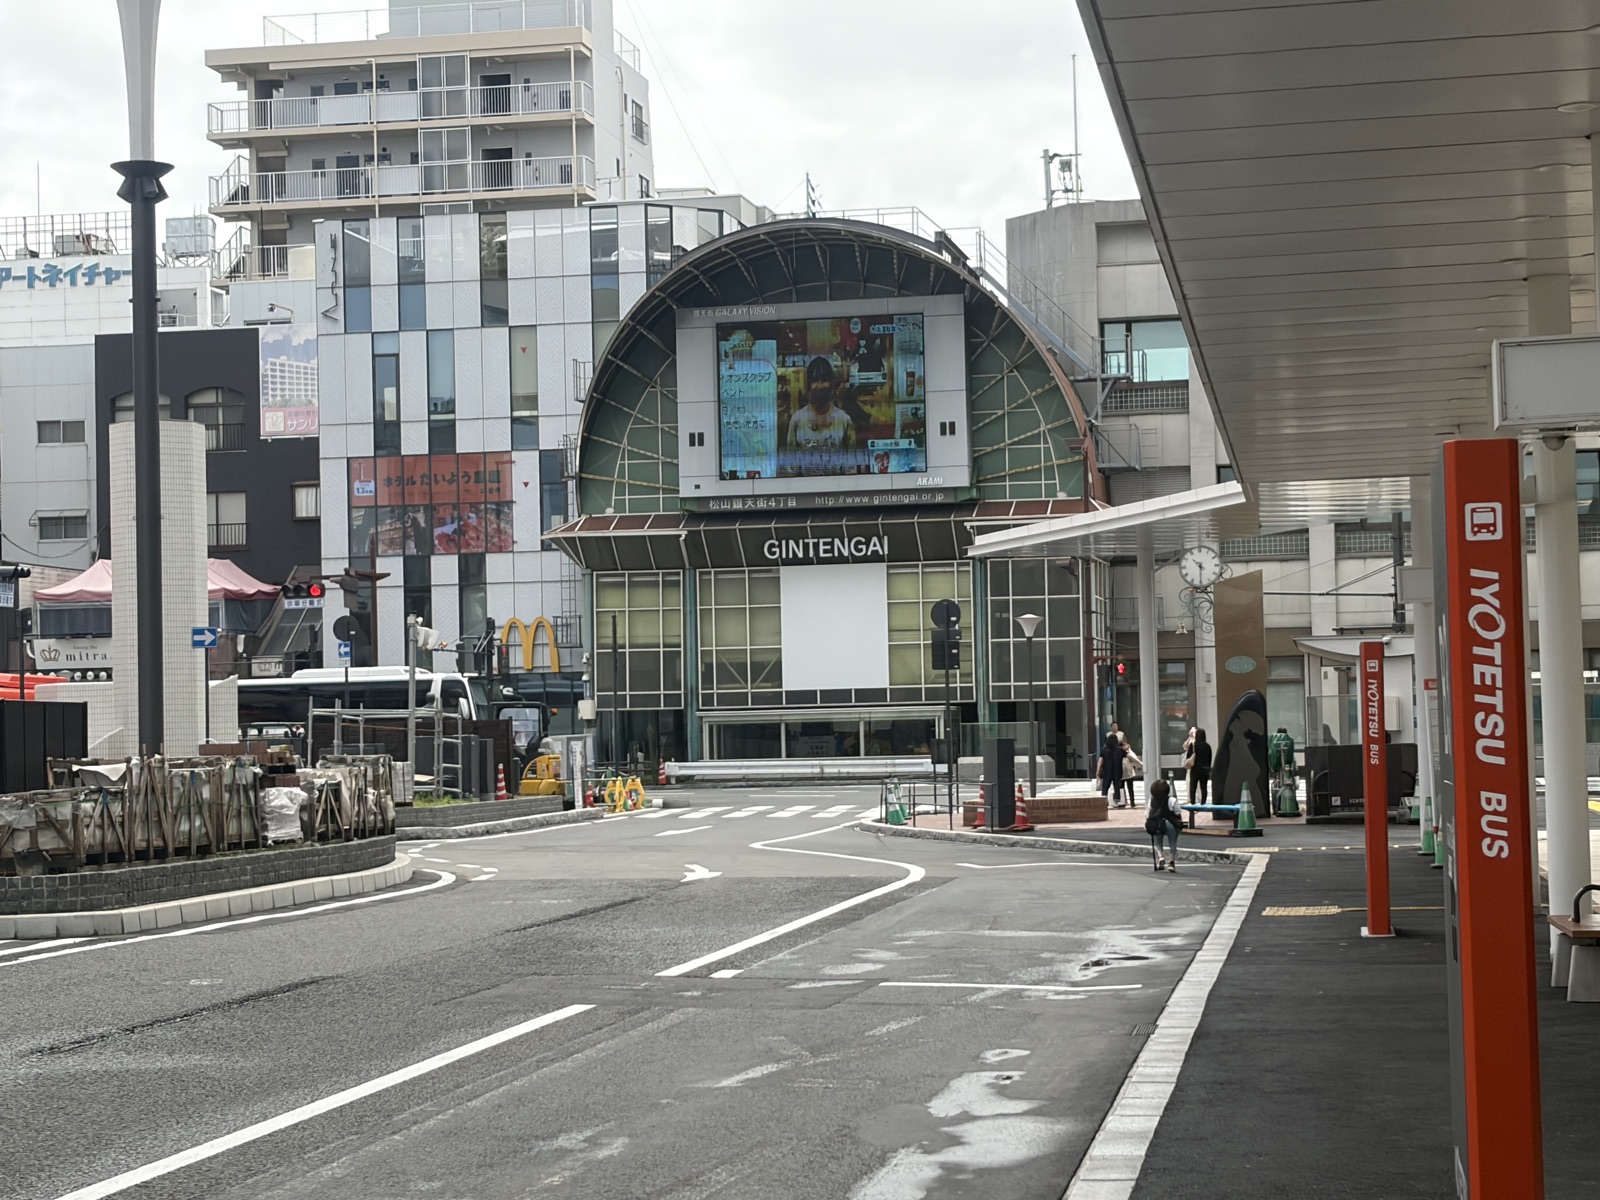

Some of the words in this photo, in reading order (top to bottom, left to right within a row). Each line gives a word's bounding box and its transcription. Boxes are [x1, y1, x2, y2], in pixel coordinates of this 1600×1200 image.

[715, 307, 748, 317] GALAXY
[749, 305, 776, 315] VISION
[916, 477, 943, 487] AKAMI
[709, 496, 797, 509] 松山銀天街4丁目
[764, 535, 889, 559] GINTENGAI
[66, 651, 107, 662] mitra
[1467, 568, 1507, 766] IYOTETSU
[1367, 679, 1380, 738] IYOTETSU
[1370, 744, 1380, 765] BUS
[1480, 790, 1509, 859] BUS
